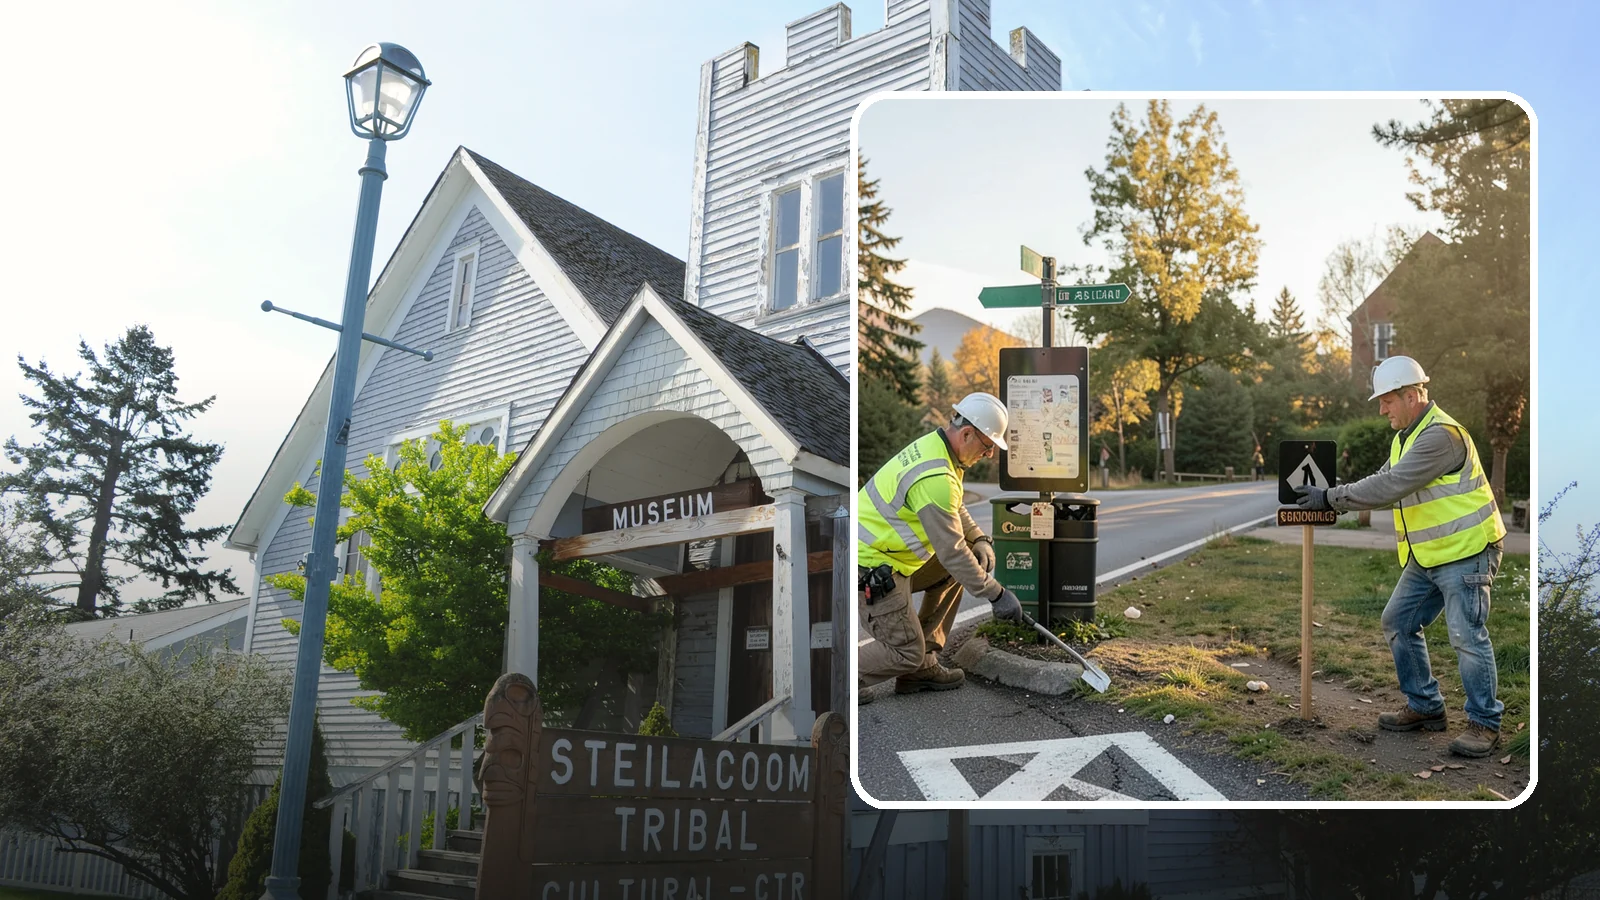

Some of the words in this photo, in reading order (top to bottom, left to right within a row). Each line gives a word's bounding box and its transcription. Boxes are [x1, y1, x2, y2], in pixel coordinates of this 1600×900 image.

[613, 491, 714, 531] MUSEUM
[550, 738, 810, 793] STEILACOOM
[615, 806, 758, 852] TRIBAL
